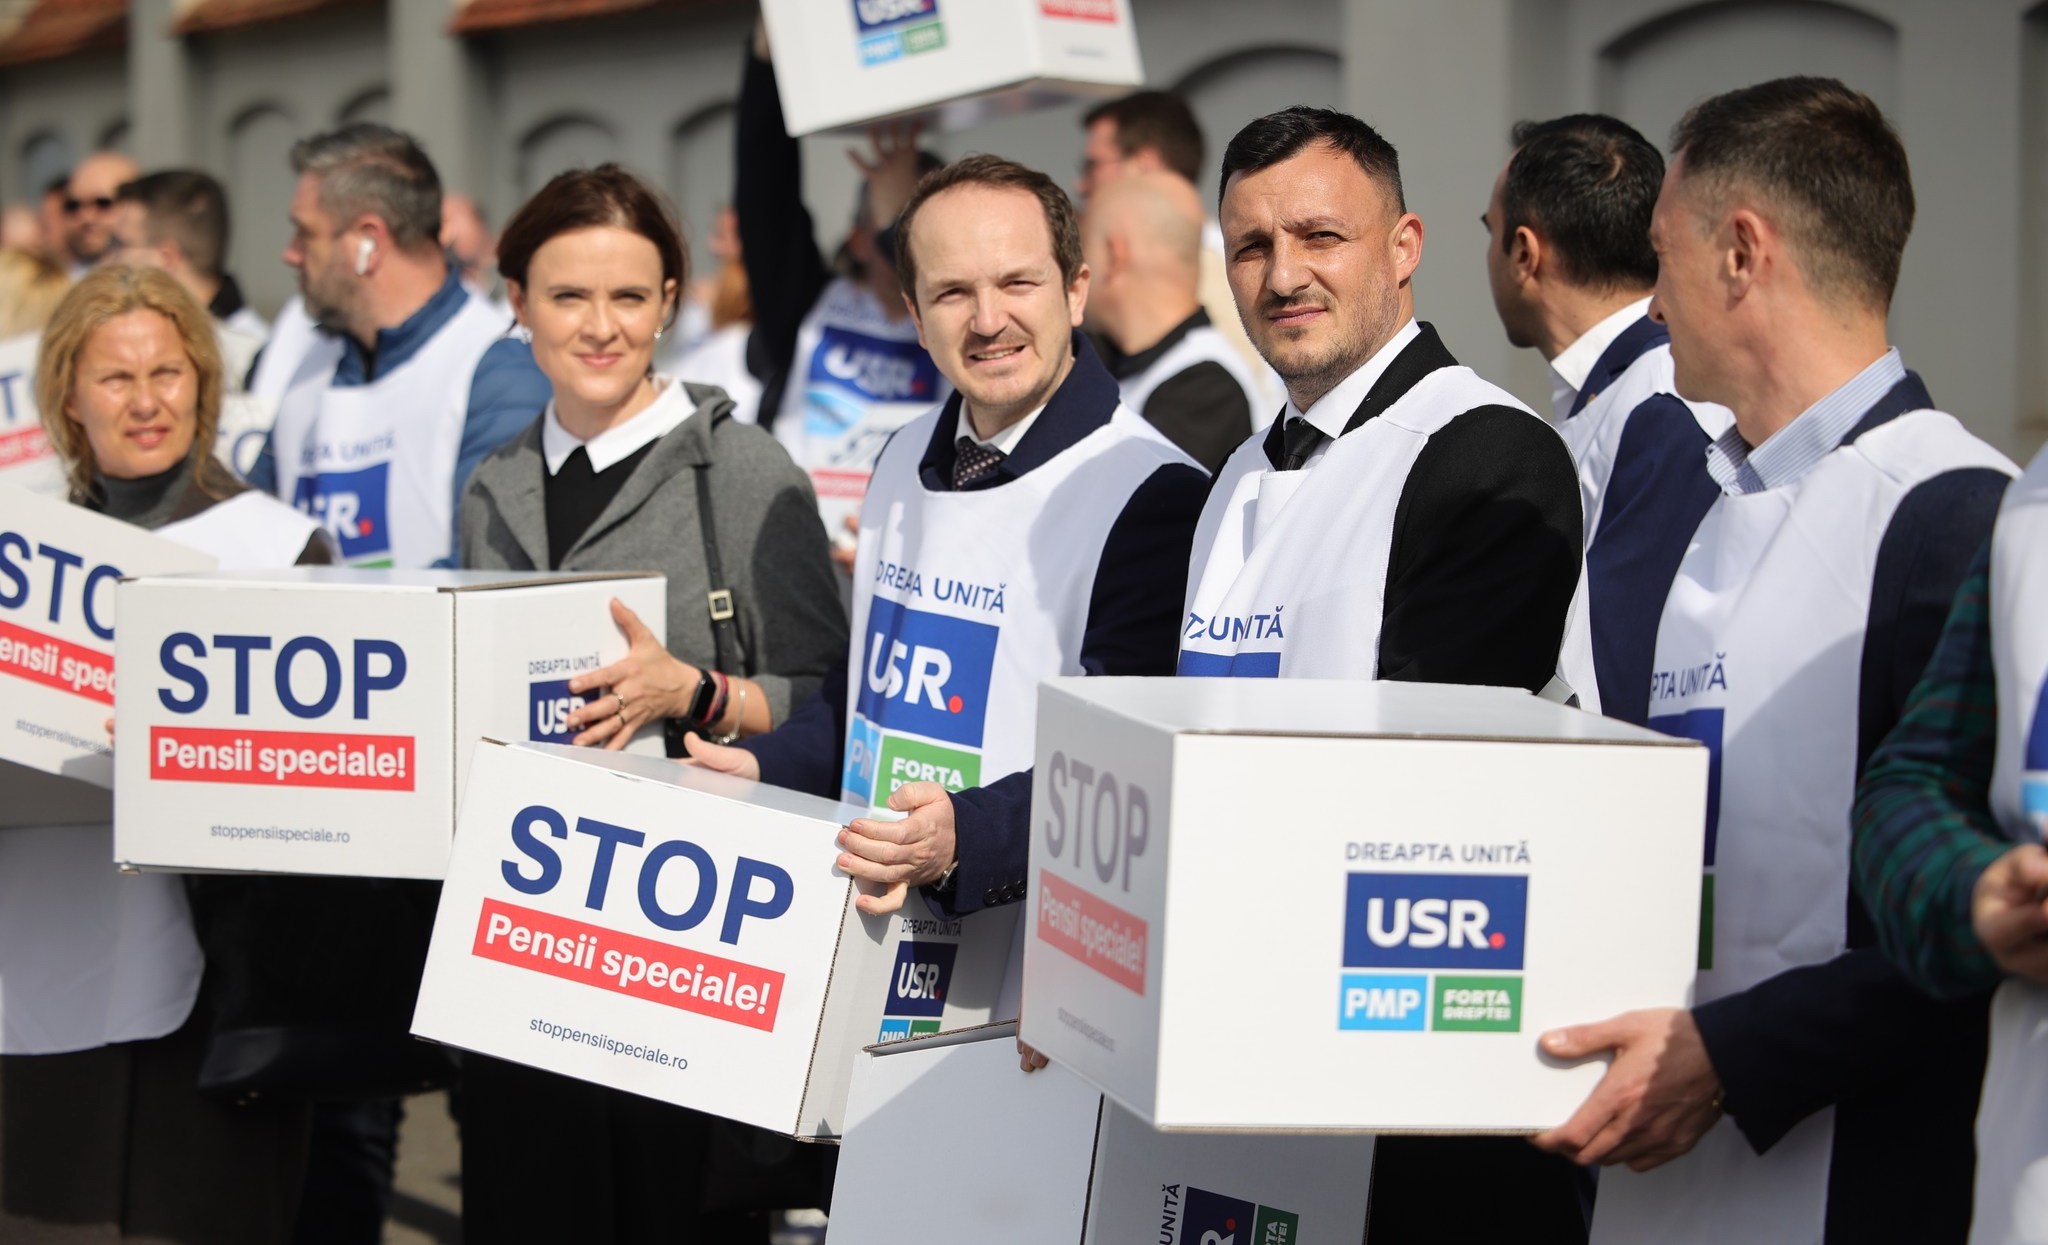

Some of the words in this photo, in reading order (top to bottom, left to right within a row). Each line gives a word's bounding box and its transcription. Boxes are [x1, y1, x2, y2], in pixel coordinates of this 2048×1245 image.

[0, 532, 124, 641] STO
[934, 577, 1007, 613] UNITĂ
[0, 637, 60, 677] ensii
[157, 631, 408, 721] STOP
[868, 632, 964, 714] USR.
[157, 739, 254, 772] Pensii
[258, 743, 406, 780] speciale!
[210, 822, 350, 845] stoppensiispeciale.ro
[1045, 750, 1149, 893] STOP
[1345, 842, 1454, 862] DREAPTA
[1461, 840, 1531, 864] UNITĂ
[501, 805, 795, 946] STOP
[901, 918, 937, 936] DREAPTA
[1367, 897, 1506, 949] USR.
[485, 913, 596, 970] Pensii
[600, 949, 772, 1015] speciale!
[897, 962, 942, 1000] USR.
[1344, 987, 1421, 1019] PMP
[1442, 1006, 1512, 1021] DREPTEI
[529, 1016, 689, 1071] stoppensiispeciale.ro
